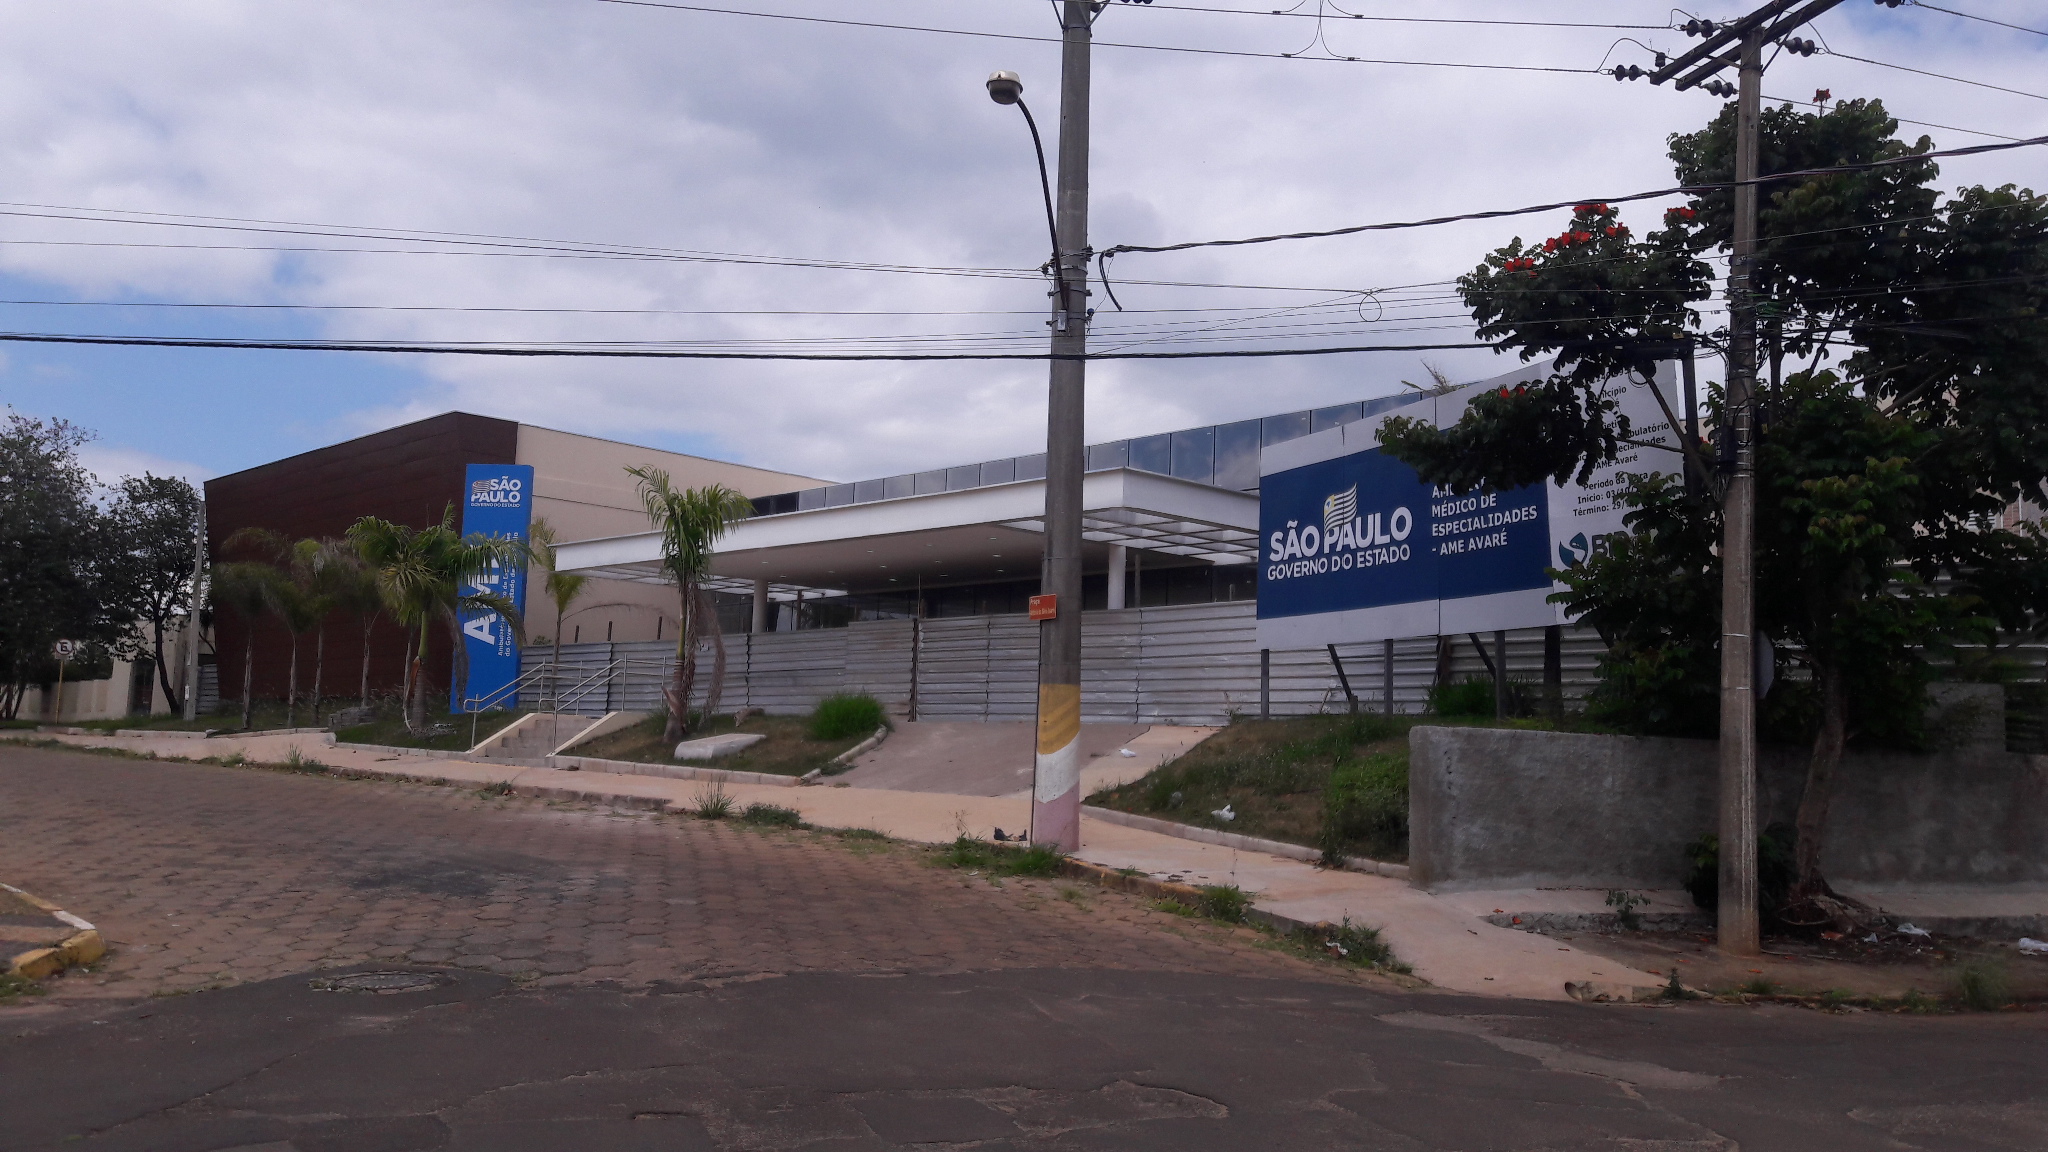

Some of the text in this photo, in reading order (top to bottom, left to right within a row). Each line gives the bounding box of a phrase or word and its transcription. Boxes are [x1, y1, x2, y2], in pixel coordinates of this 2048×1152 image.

[1614, 453, 1638, 465] Avaré
[490, 476, 522, 491] SÃO
[470, 491, 521, 503] PAULO
[1431, 493, 1497, 518] MÉDICO DE
[1432, 505, 1538, 537] ESPECIALIDADES
[1572, 505, 1609, 517] Término:
[1269, 506, 1413, 562] SÃO PAULO
[1440, 540, 1465, 556] AME
[1468, 528, 1508, 552] AVARÉ
[1267, 543, 1411, 581] GOVERNO DO ESTADO
